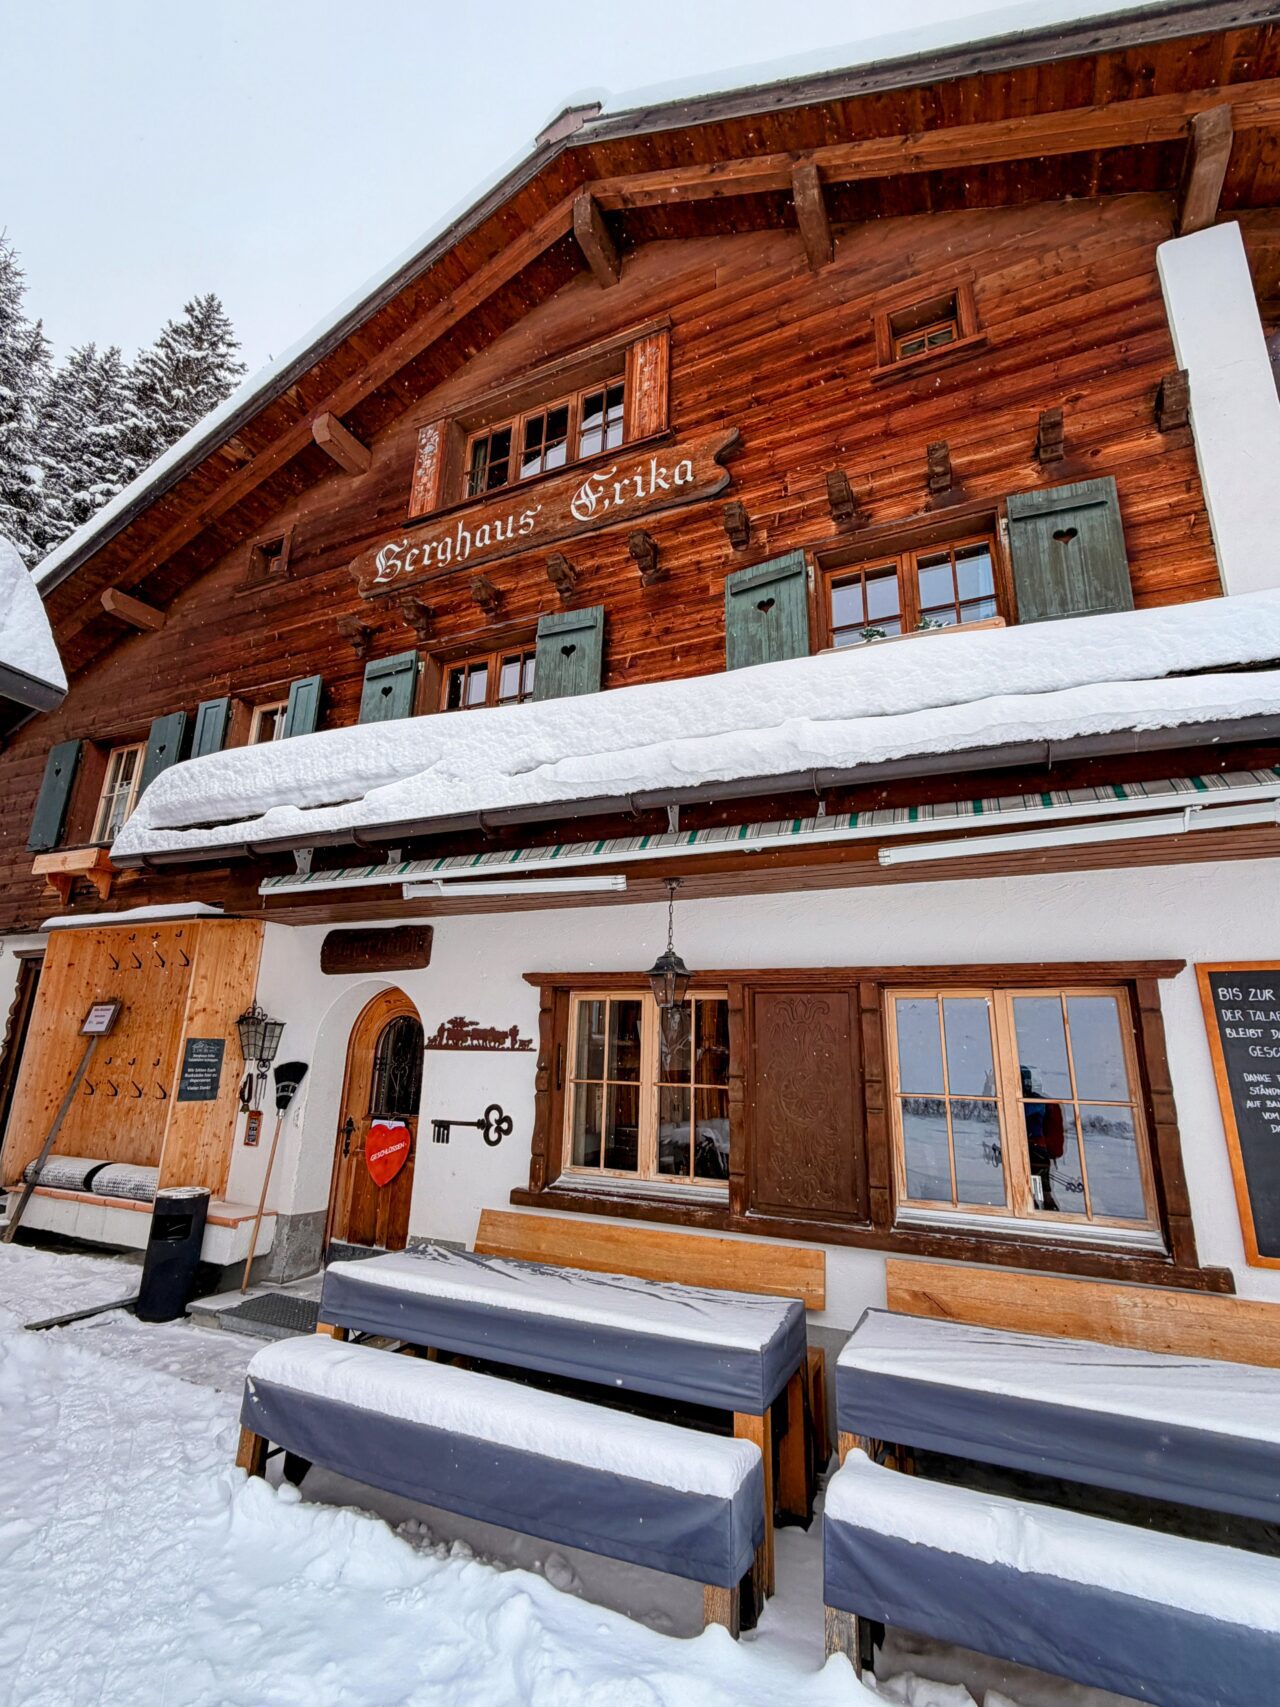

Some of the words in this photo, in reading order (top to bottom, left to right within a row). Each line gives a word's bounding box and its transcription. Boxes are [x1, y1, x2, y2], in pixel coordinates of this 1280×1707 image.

[372, 504, 542, 584] Berghaus
[570, 455, 695, 522] Erika
[1217, 987, 1243, 1001] BIS
[1248, 988, 1276, 1001] ZUR
[1221, 1009, 1245, 1021] DER
[1225, 1027, 1264, 1039] BLEIBT
[1248, 1045, 1280, 1058] GESC
[1243, 1072, 1272, 1083] DANKE
[1246, 1100, 1262, 1109] AUF
